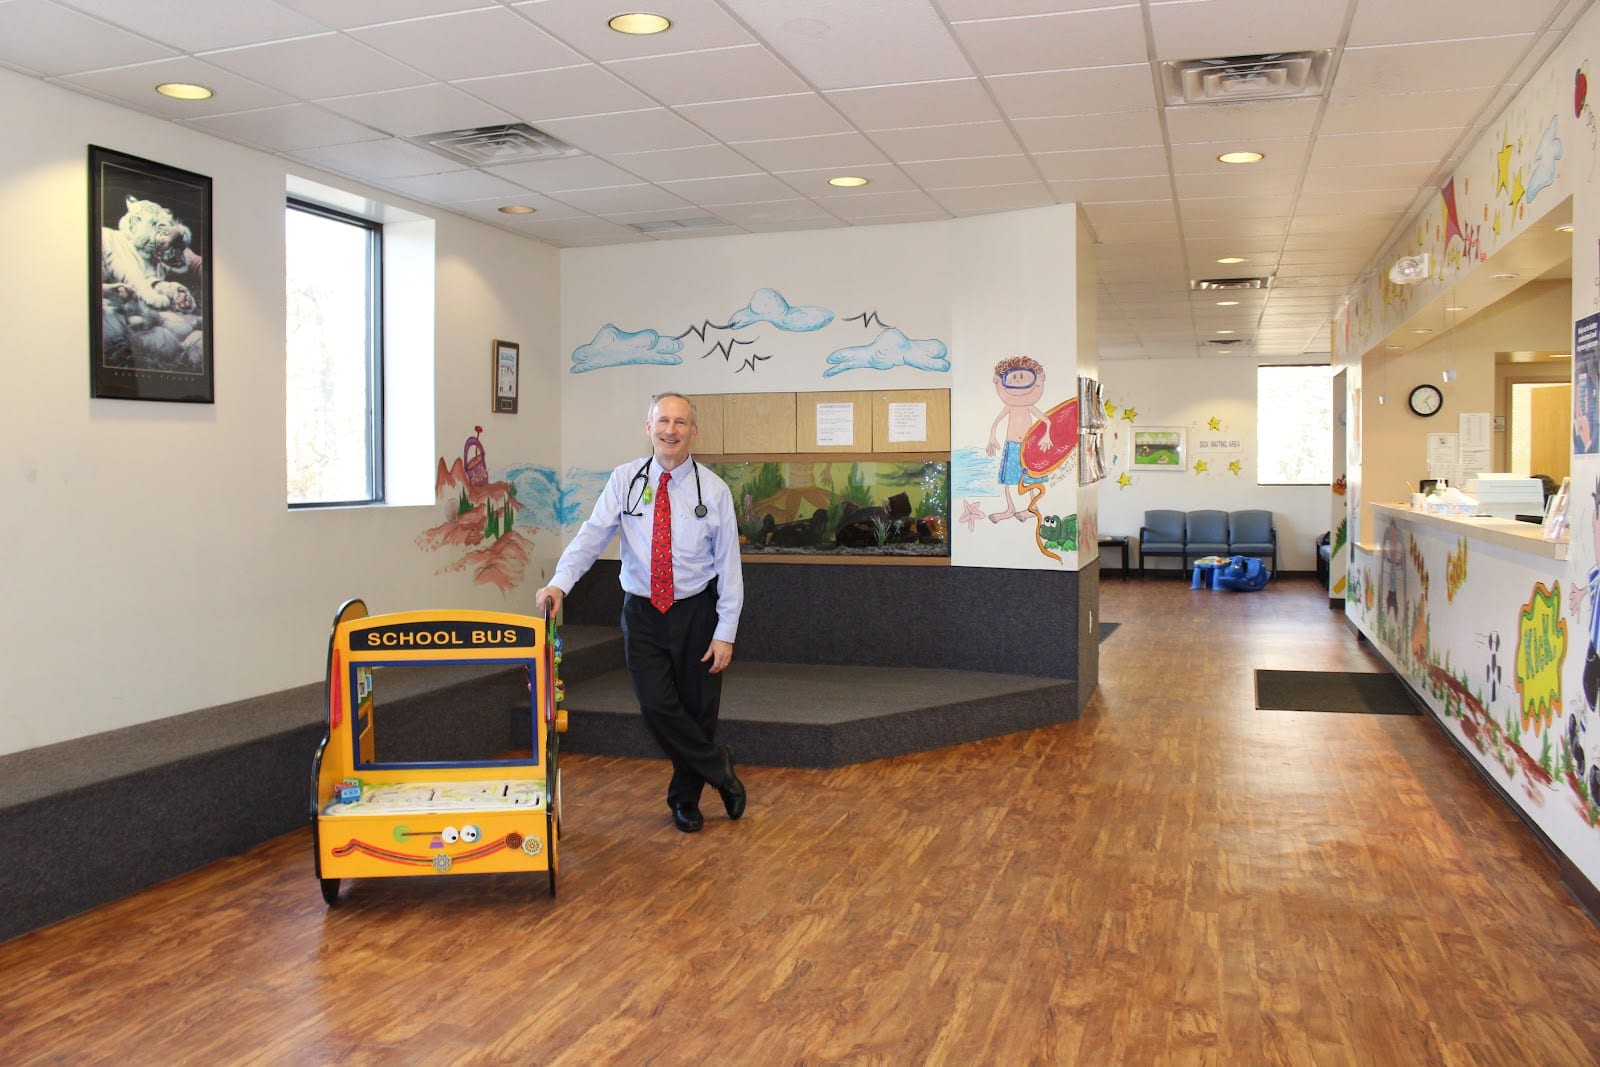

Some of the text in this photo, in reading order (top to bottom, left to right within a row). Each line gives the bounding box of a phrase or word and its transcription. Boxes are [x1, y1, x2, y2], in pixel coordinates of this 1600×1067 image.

[1210, 440, 1228, 448] WAITING
[1229, 440, 1241, 448] AREA
[367, 629, 517, 646] SCHOOL BUS
